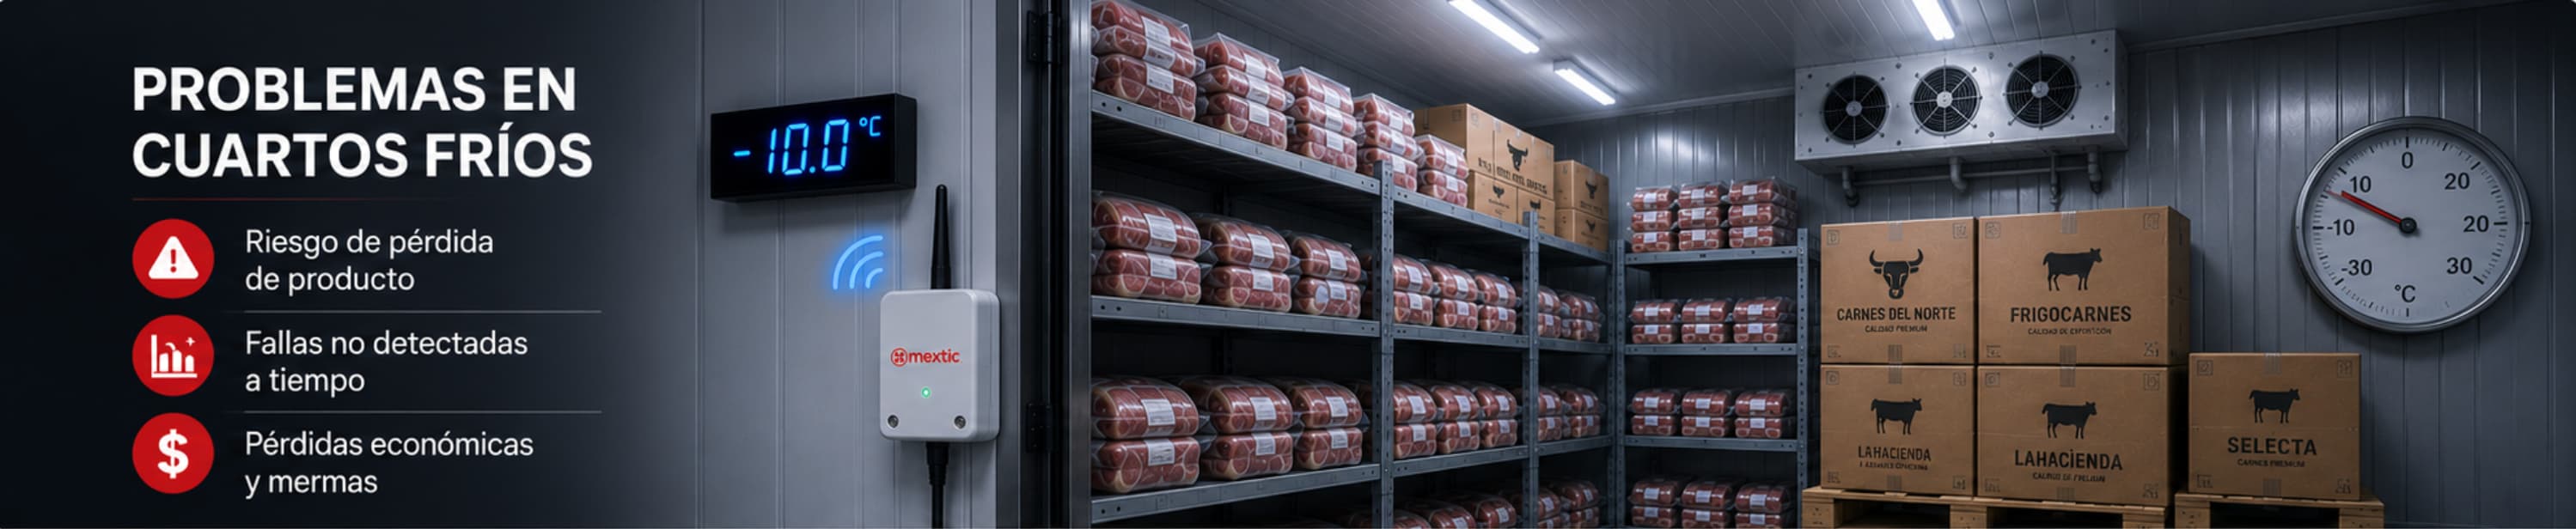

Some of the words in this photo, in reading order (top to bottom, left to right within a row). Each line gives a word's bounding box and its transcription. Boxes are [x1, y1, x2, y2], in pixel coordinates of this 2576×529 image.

[733, 119, 849, 175] -10.0
[859, 115, 882, 137] °C
[2402, 151, 2414, 169] 0
[2350, 175, 2372, 193] 10
[2445, 173, 2470, 190] 20
[2327, 219, 2355, 236] -10
[2463, 215, 2489, 233] 20
[2341, 258, 2372, 276] -30
[2446, 257, 2473, 275] 30
[2395, 284, 2416, 302] °C
[1837, 308, 1885, 320] CARNES
[1889, 307, 1911, 319] DEL
[1914, 307, 1956, 319] NORTE
[2011, 306, 2132, 323] FRIGOCARNES
[908, 349, 961, 363] mextic
[2227, 437, 2317, 455] SELECTA
